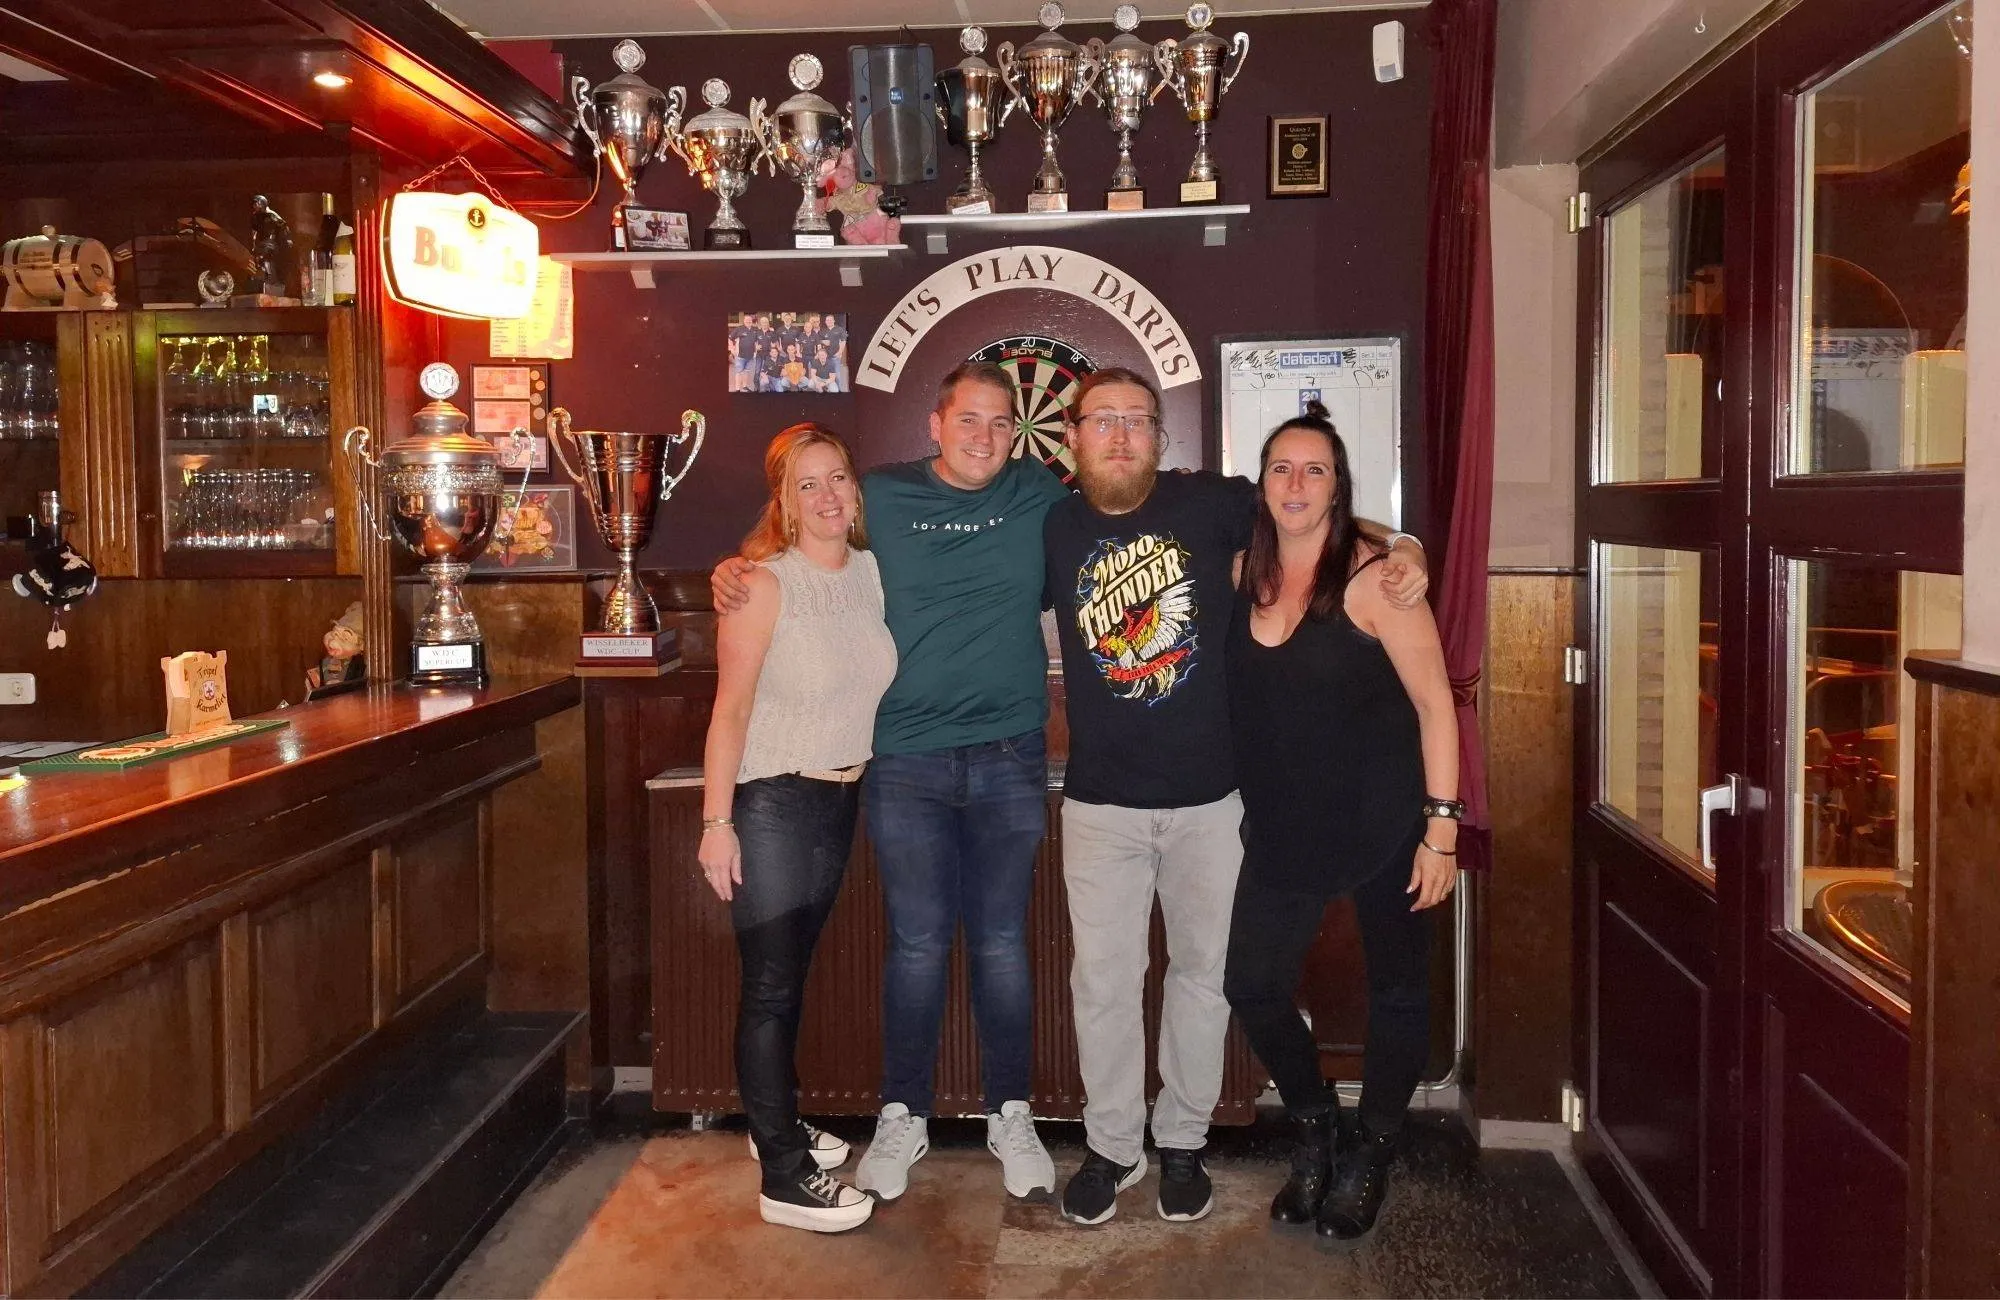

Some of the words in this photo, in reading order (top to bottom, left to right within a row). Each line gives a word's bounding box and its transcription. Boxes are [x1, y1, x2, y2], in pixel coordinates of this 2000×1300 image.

[867, 289, 941, 379] LET'S
[963, 254, 1063, 292] PLAY
[1091, 269, 1190, 376] DARTS
[1021, 338, 1036, 348] 20
[1281, 351, 1338, 366] datadart
[944, 517, 1004, 532] ANGEE
[1078, 548, 1184, 650] THUNDER
[196, 665, 218, 679] Tripel
[196, 693, 227, 713] Karmeliet
